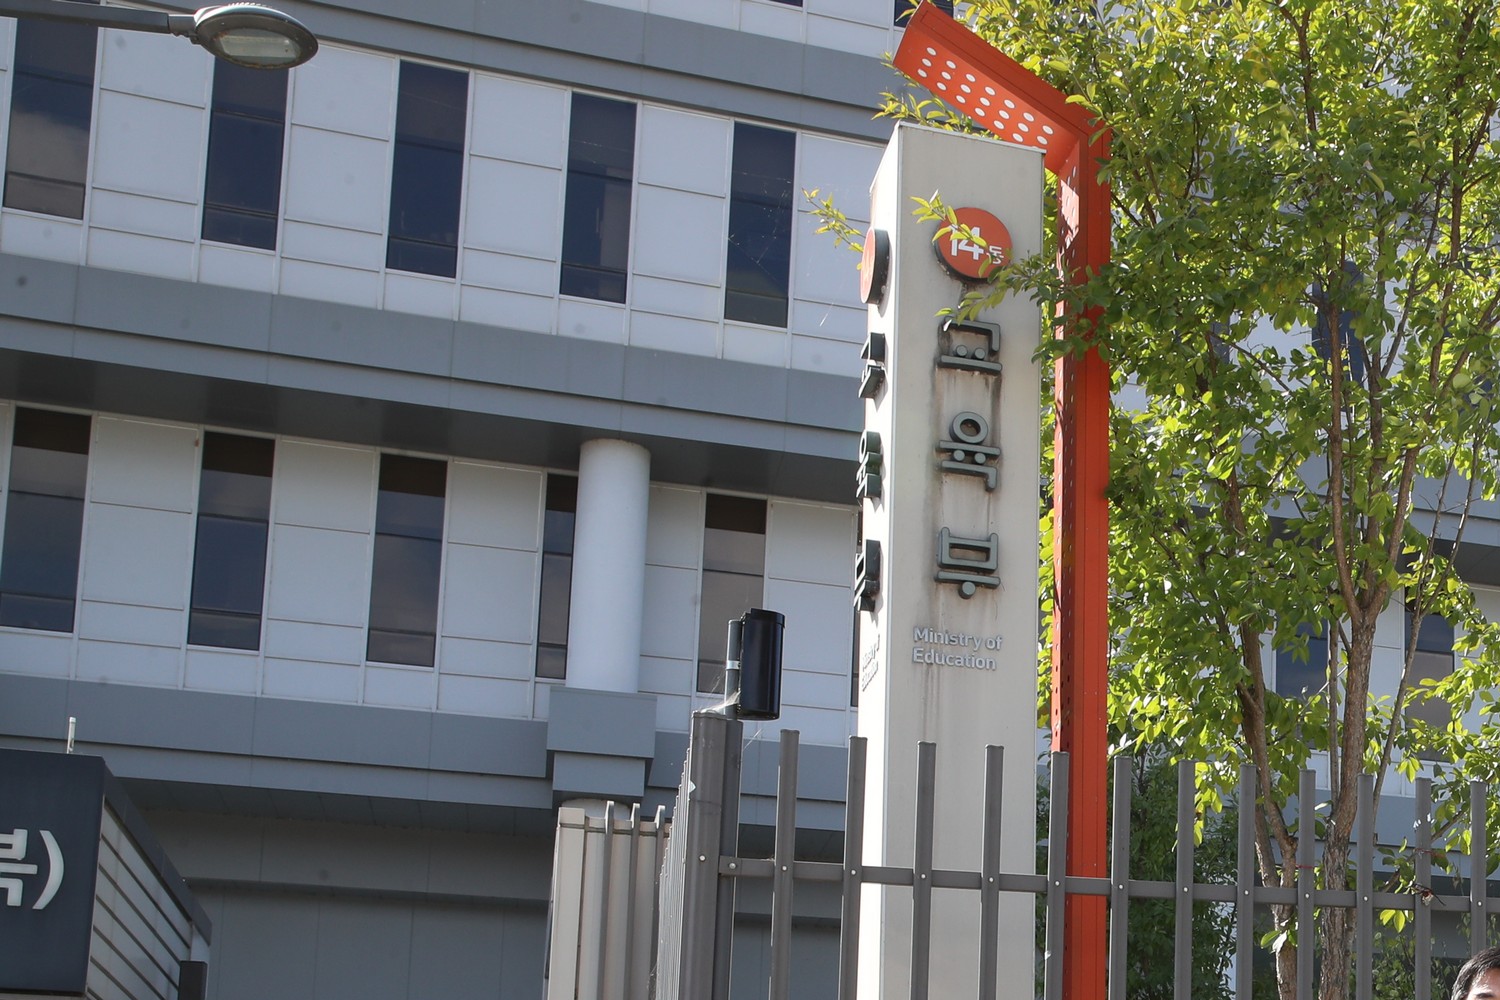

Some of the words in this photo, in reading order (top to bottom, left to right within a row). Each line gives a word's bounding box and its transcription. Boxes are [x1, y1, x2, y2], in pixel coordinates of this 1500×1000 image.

[938, 315, 1002, 598] 교육부
[912, 627, 982, 651] Ministry
[985, 636, 1003, 650] of
[912, 647, 997, 671] Education
